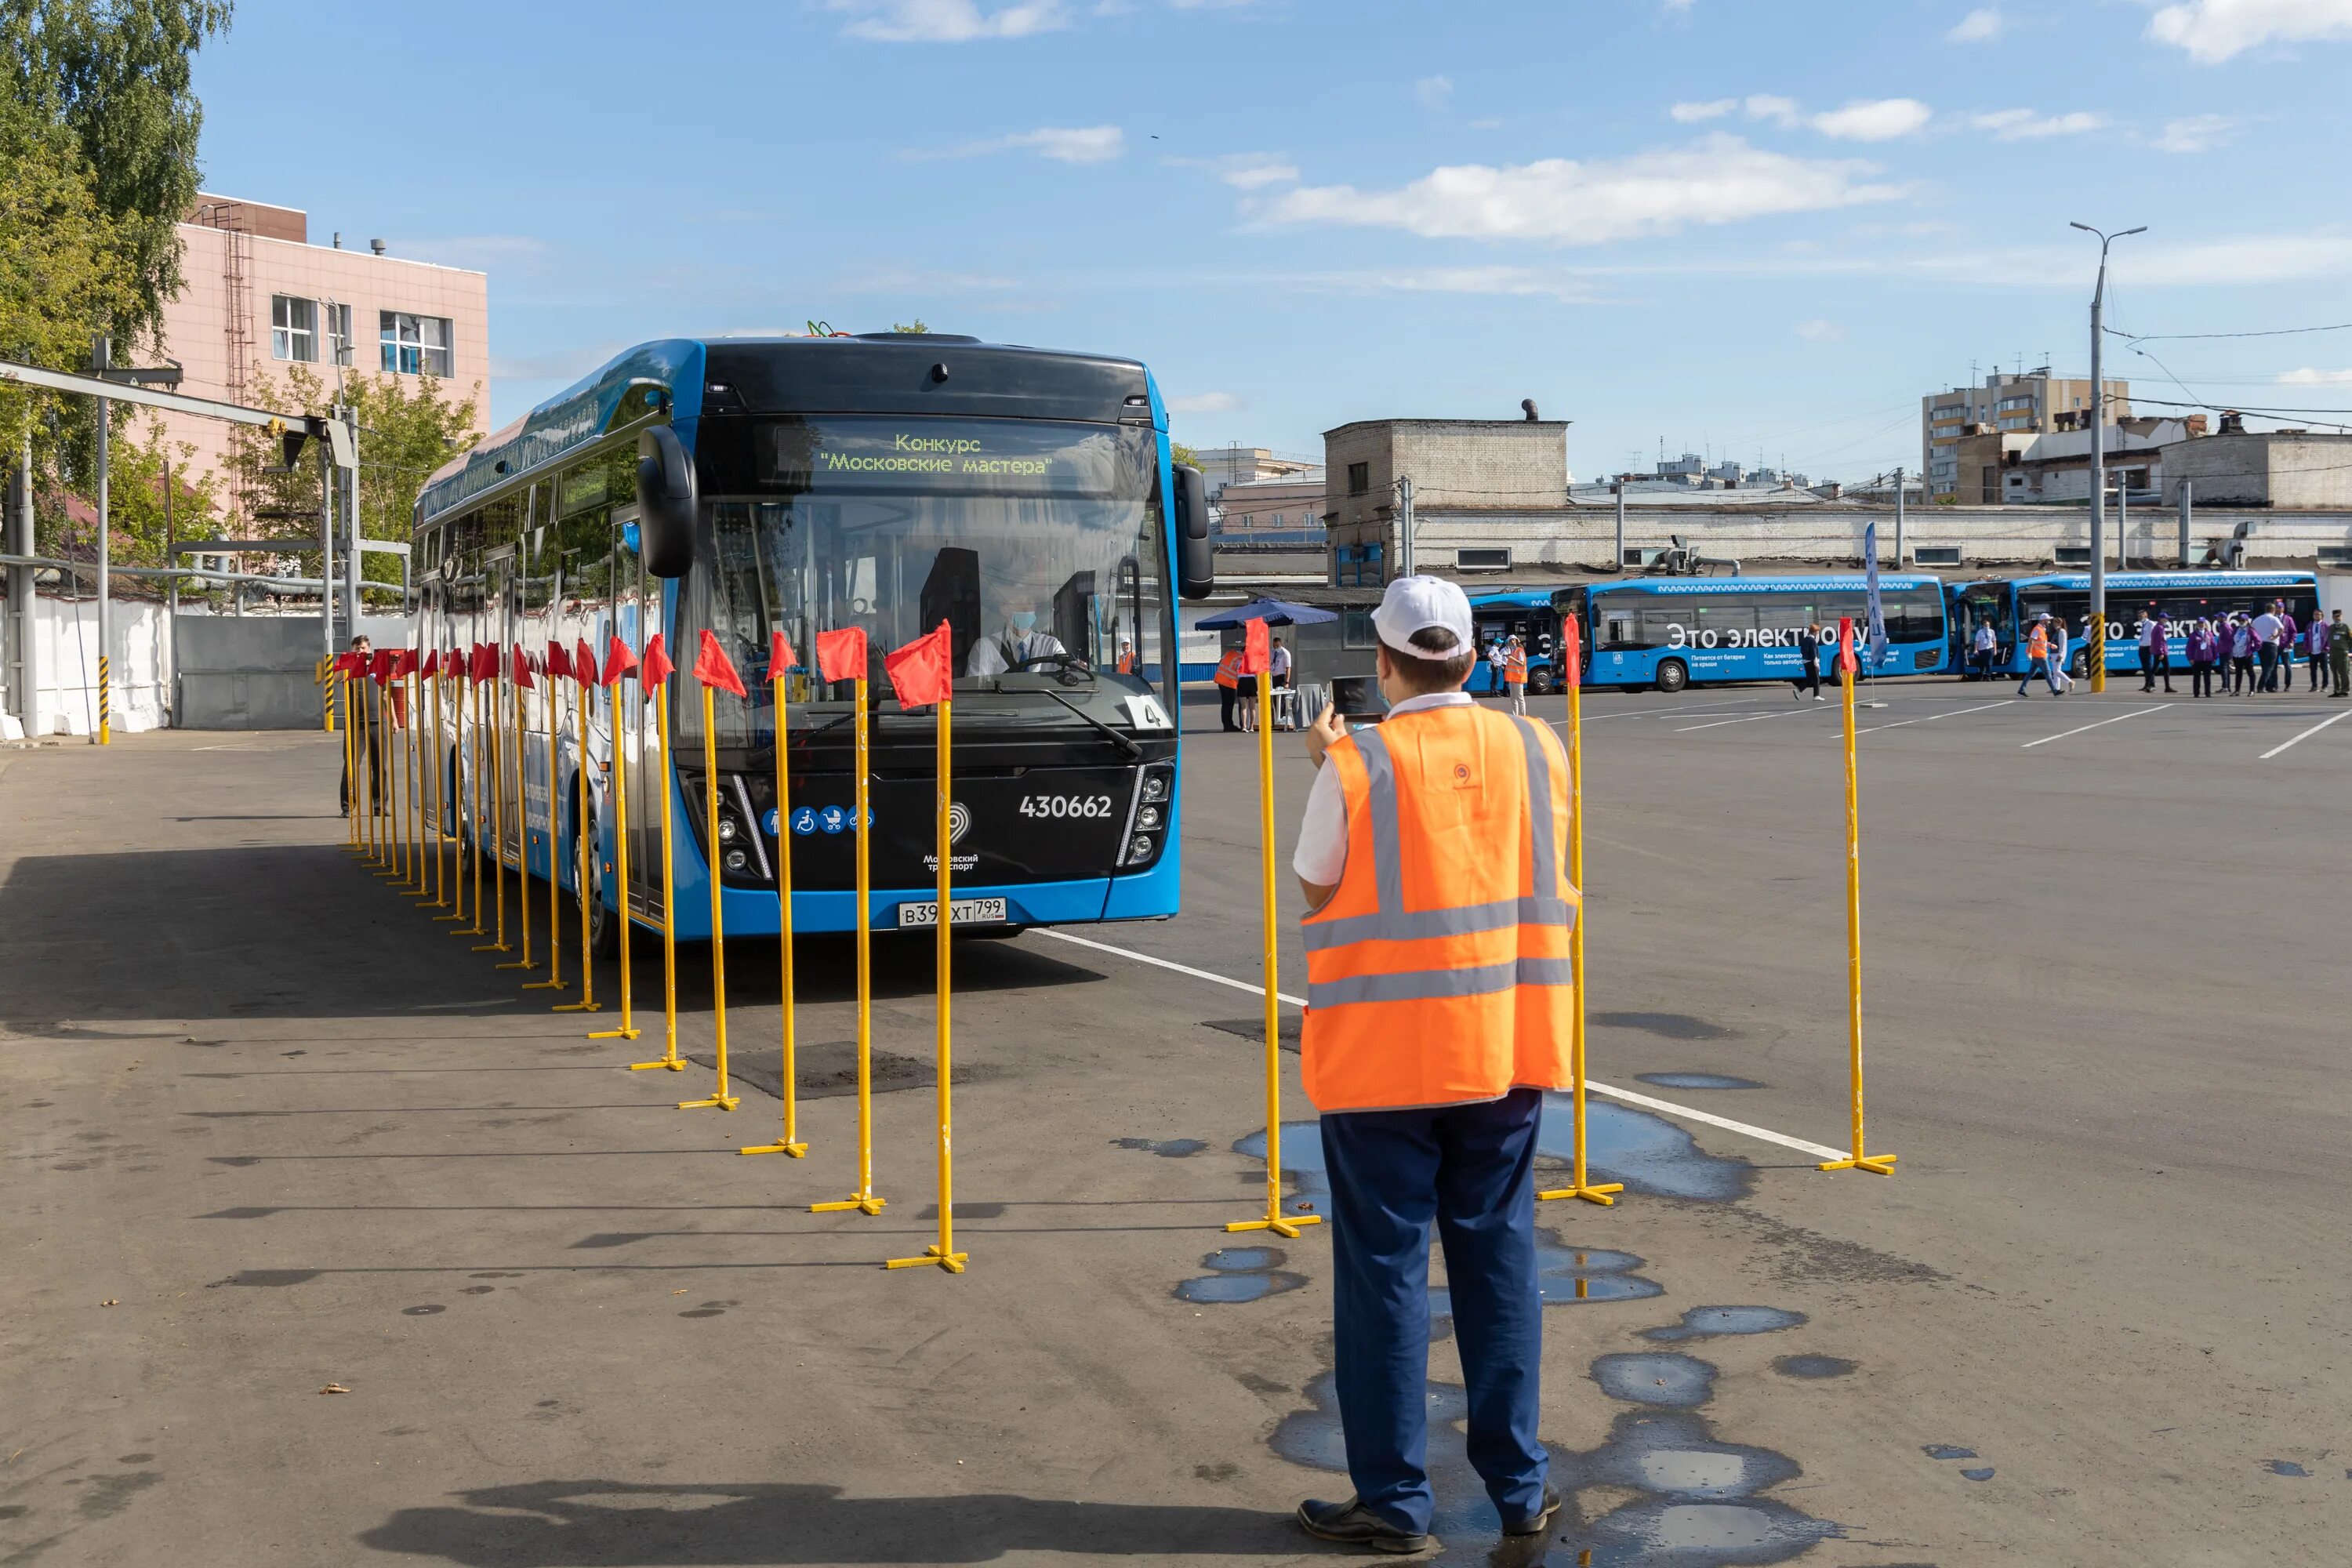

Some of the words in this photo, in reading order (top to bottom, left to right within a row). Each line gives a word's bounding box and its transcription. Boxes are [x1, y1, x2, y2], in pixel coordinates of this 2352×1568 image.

[895, 434, 981, 454] Конкурс
[820, 452, 953, 472] "Московские
[962, 458, 1053, 476] мастера"
[1667, 623, 1718, 649] Это
[1727, 625, 1889, 652] электоу
[1145, 704, 1161, 728] 4
[1019, 796, 1112, 818] 430662
[923, 854, 978, 863] Моовский
[927, 863, 974, 872] трспорт
[906, 905, 972, 924] В39ХТ
[975, 900, 1001, 914] 799
